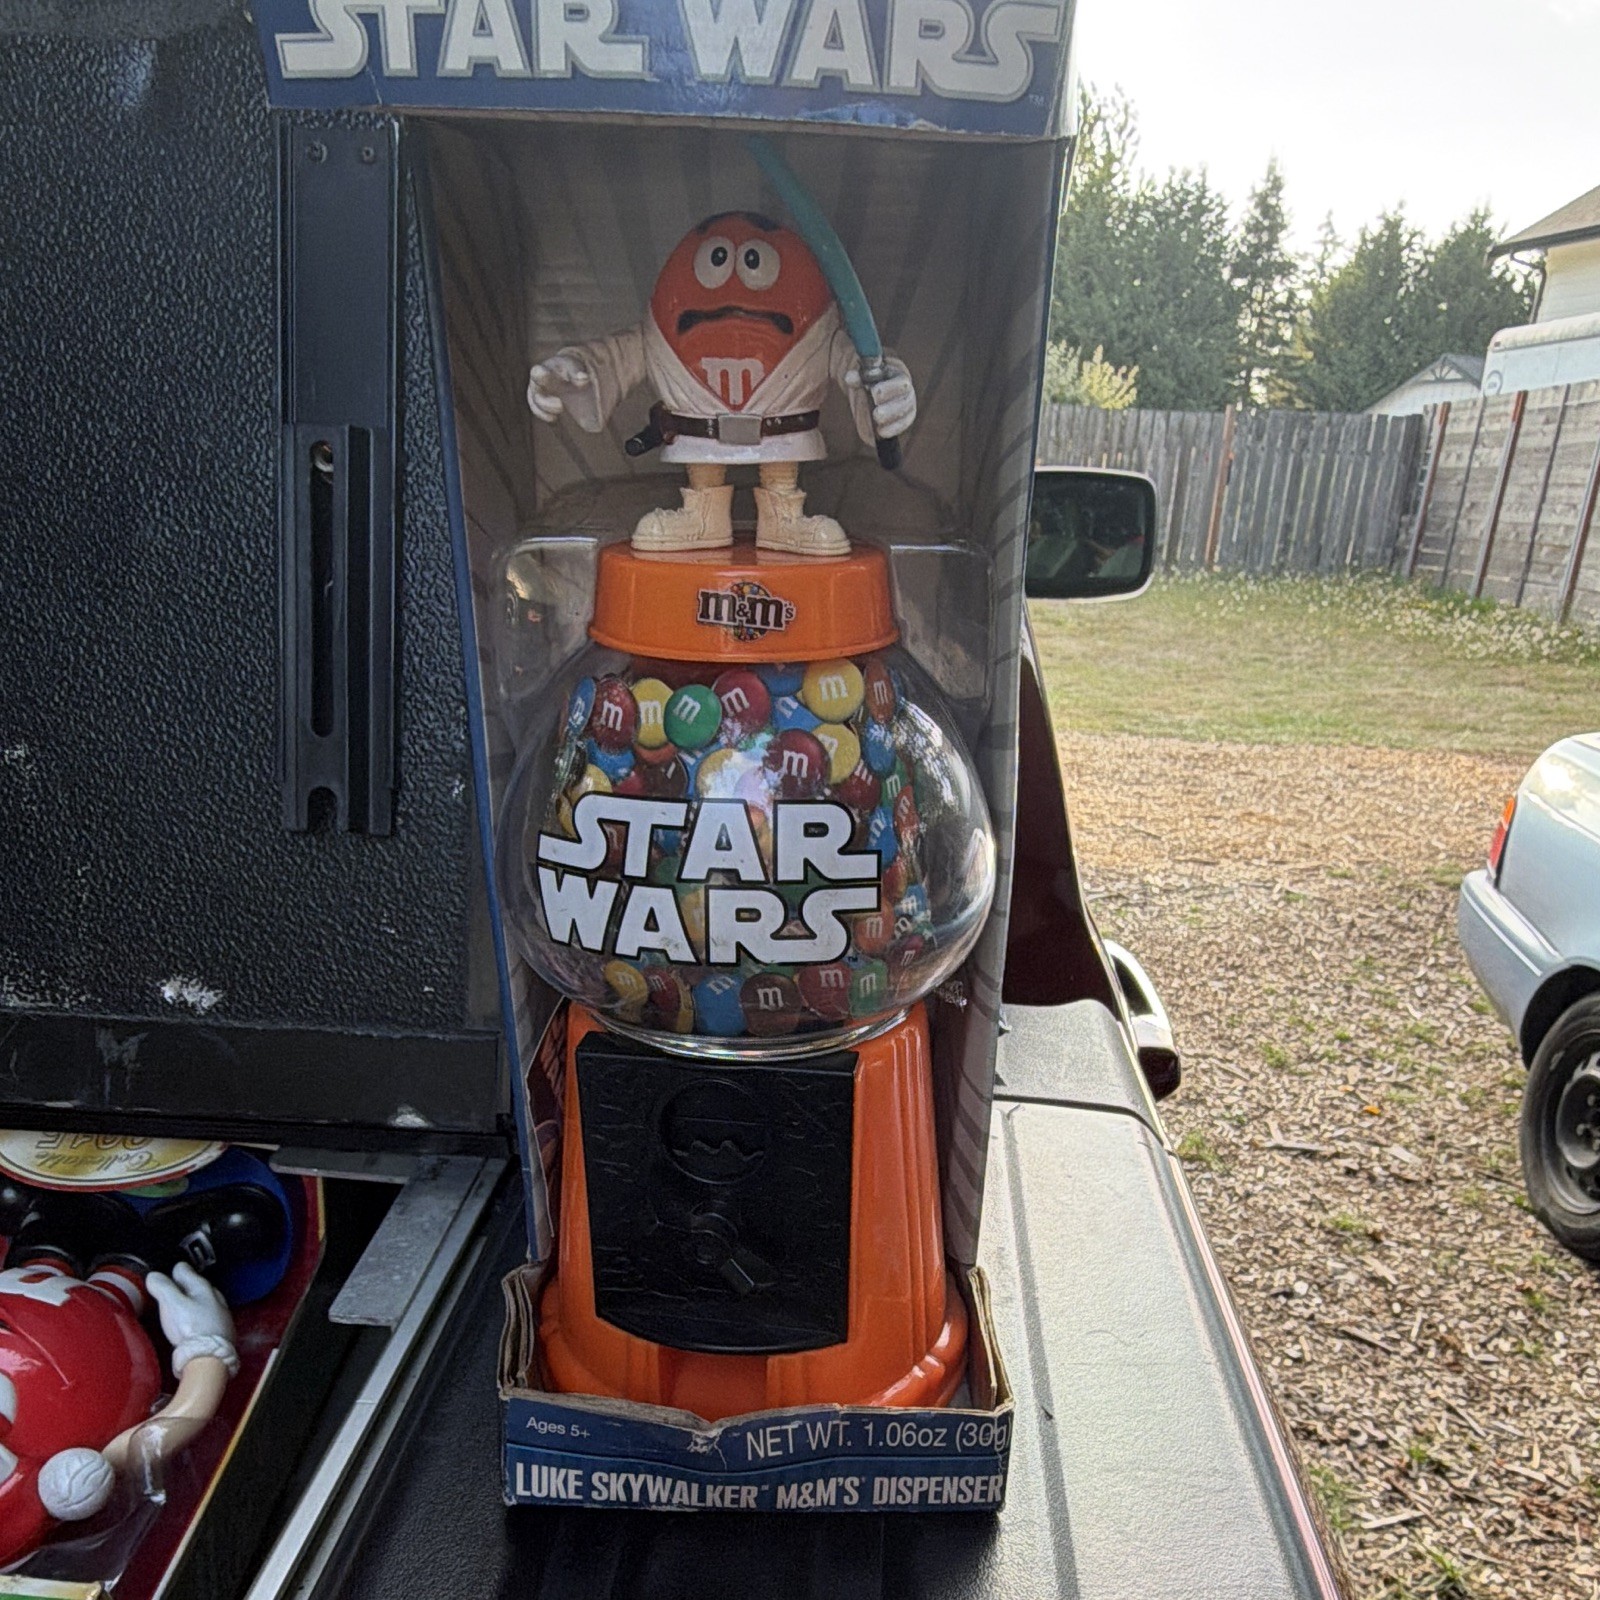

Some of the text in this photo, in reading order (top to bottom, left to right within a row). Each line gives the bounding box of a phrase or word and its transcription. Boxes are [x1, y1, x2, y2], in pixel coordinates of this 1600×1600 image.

[275, 0, 1061, 103] STAR WARS
[537, 790, 882, 884] STAR
[537, 865, 882, 966] WARS
[526, 1416, 591, 1439] Ages 5+
[746, 1421, 801, 1461] NET
[806, 1419, 852, 1450] WT.
[863, 1421, 947, 1448] 1.06oz
[515, 1462, 584, 1500] LUKE
[872, 1475, 1004, 1506] DISPENSER
